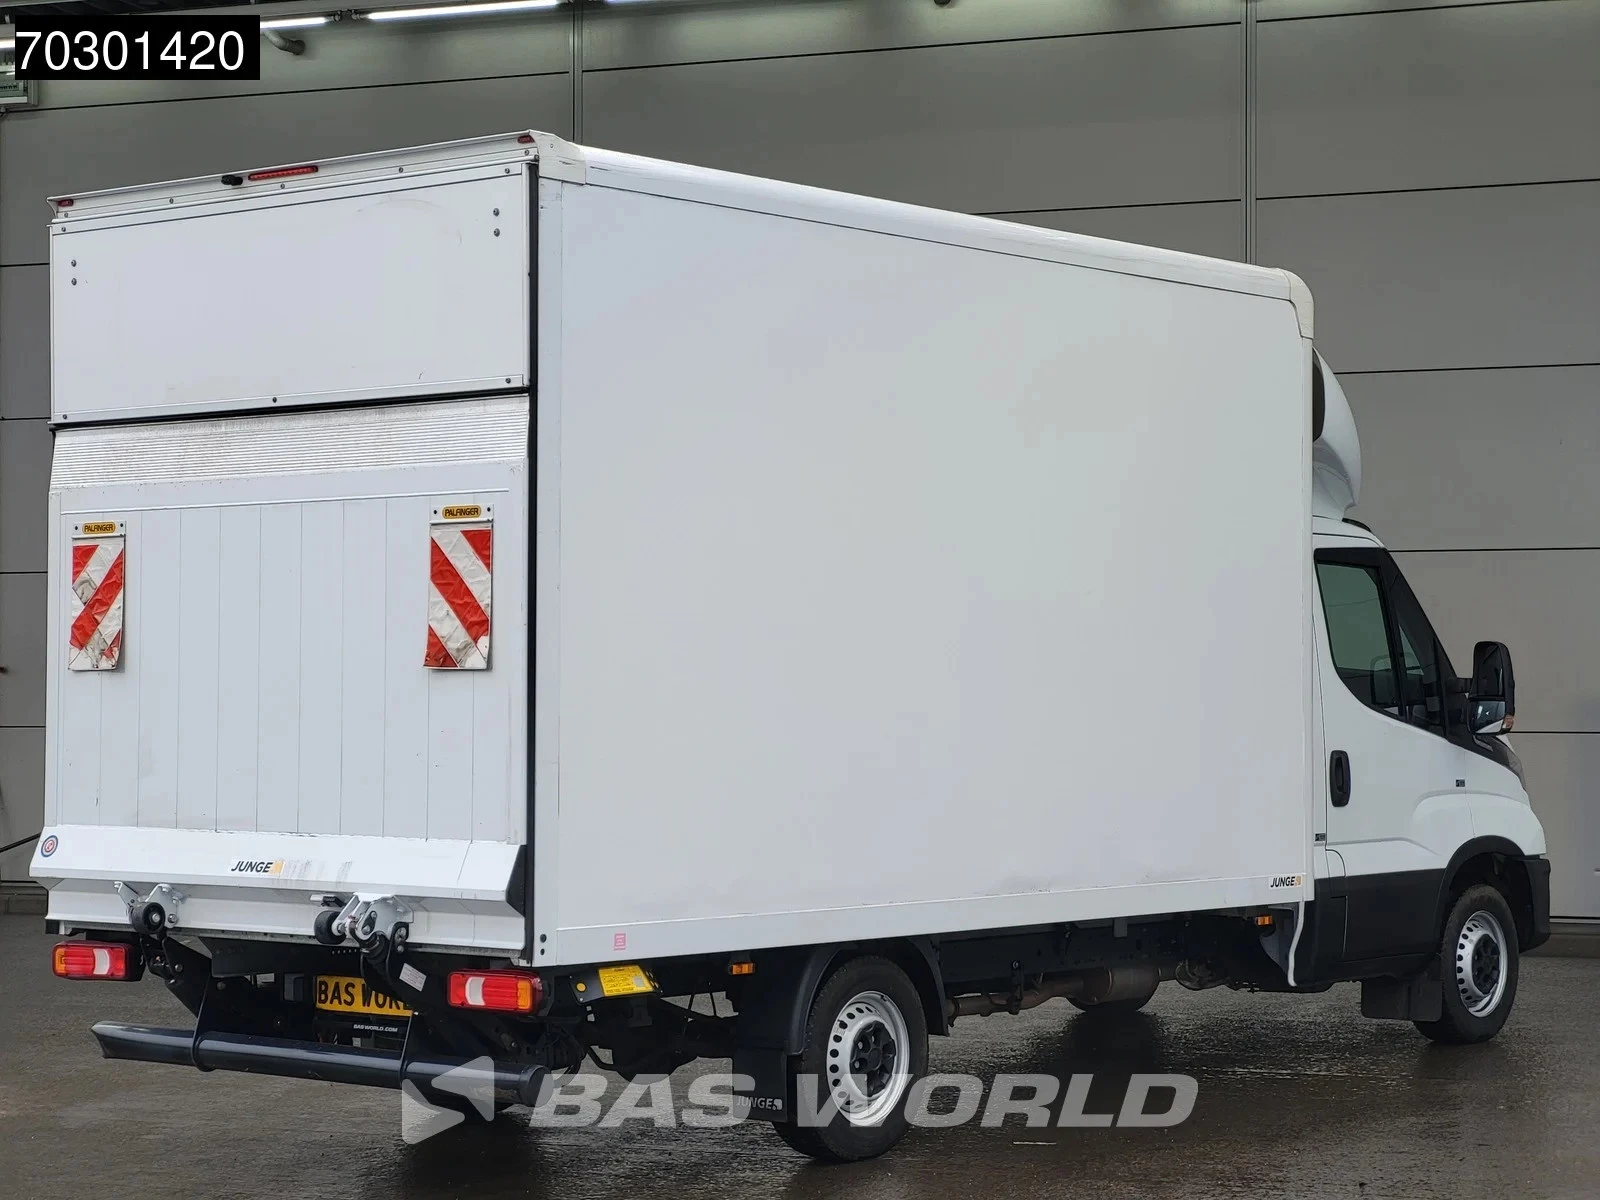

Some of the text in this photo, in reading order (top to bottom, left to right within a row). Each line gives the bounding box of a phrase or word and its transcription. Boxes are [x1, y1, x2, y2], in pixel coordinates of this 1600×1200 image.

[444, 507, 479, 517] PALFINGER
[230, 860, 273, 873] JUNGE
[1270, 876, 1296, 888] JUNGE
[317, 980, 356, 1007] BAS
